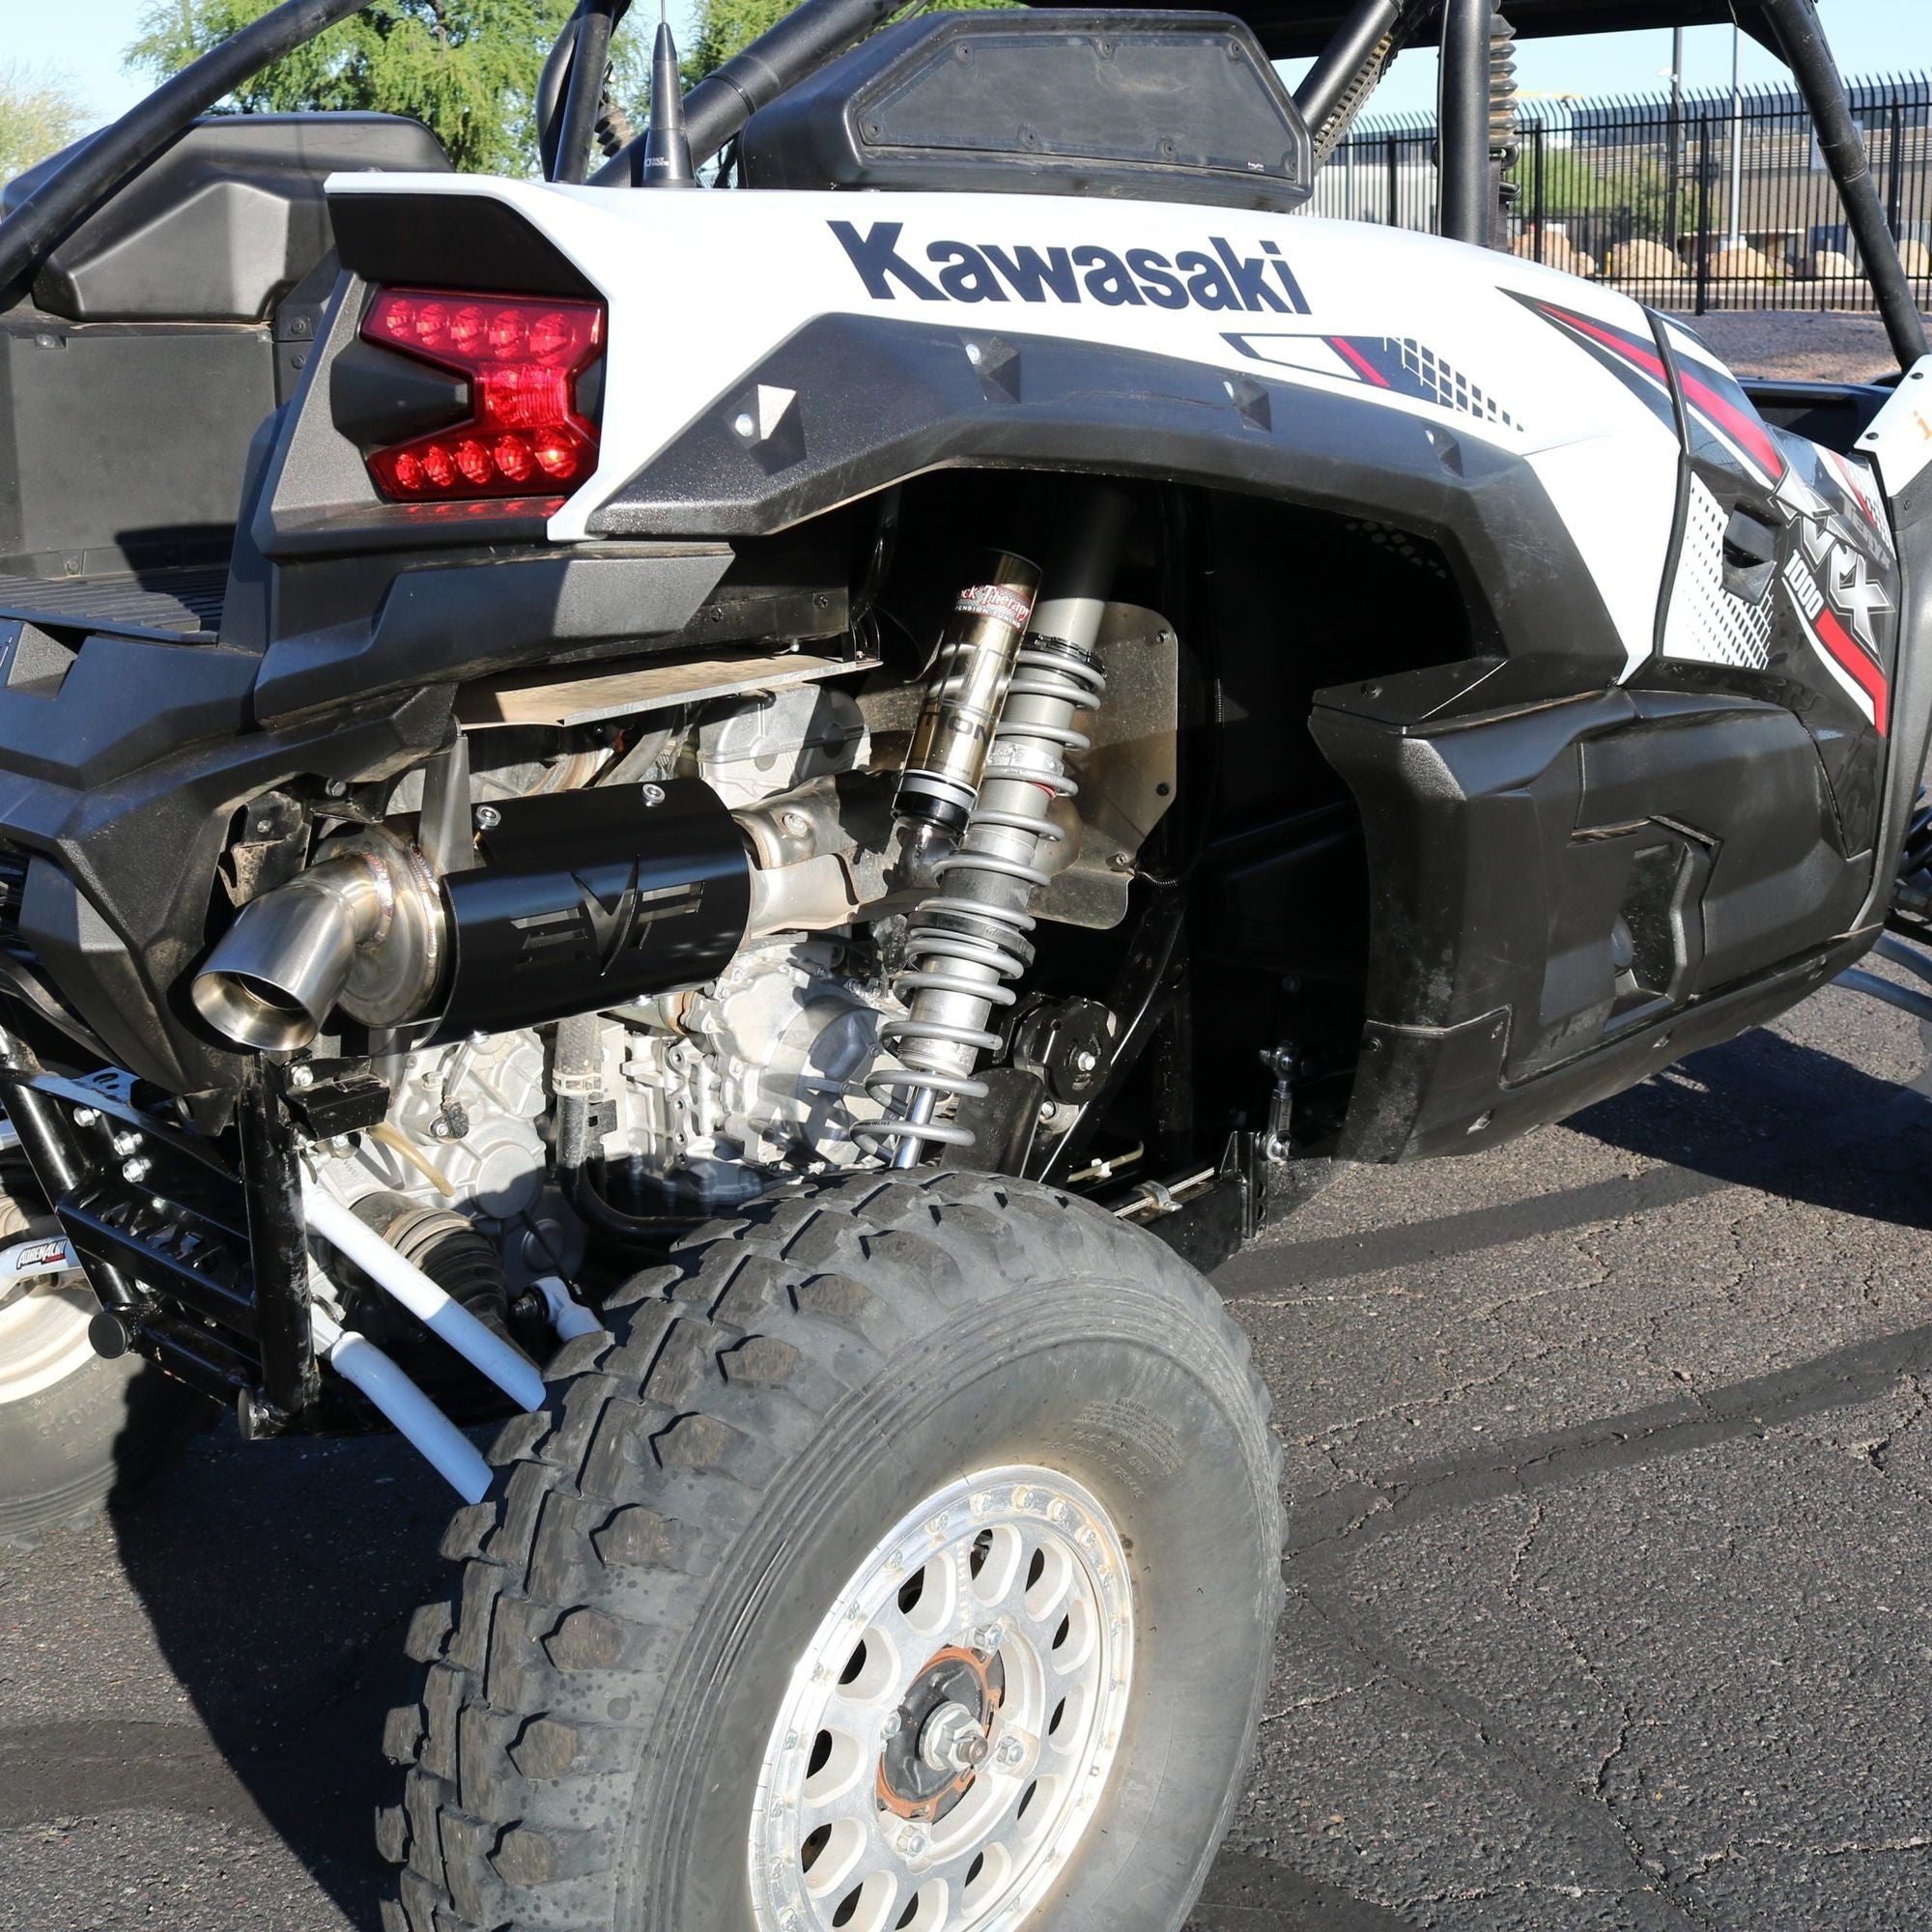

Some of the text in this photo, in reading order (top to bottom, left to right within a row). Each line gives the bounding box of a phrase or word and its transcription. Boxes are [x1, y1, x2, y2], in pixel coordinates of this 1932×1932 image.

[826, 220, 1313, 315] Kawasaki
[980, 584, 1031, 621] Therapy
[1783, 549, 1825, 620] 1000
